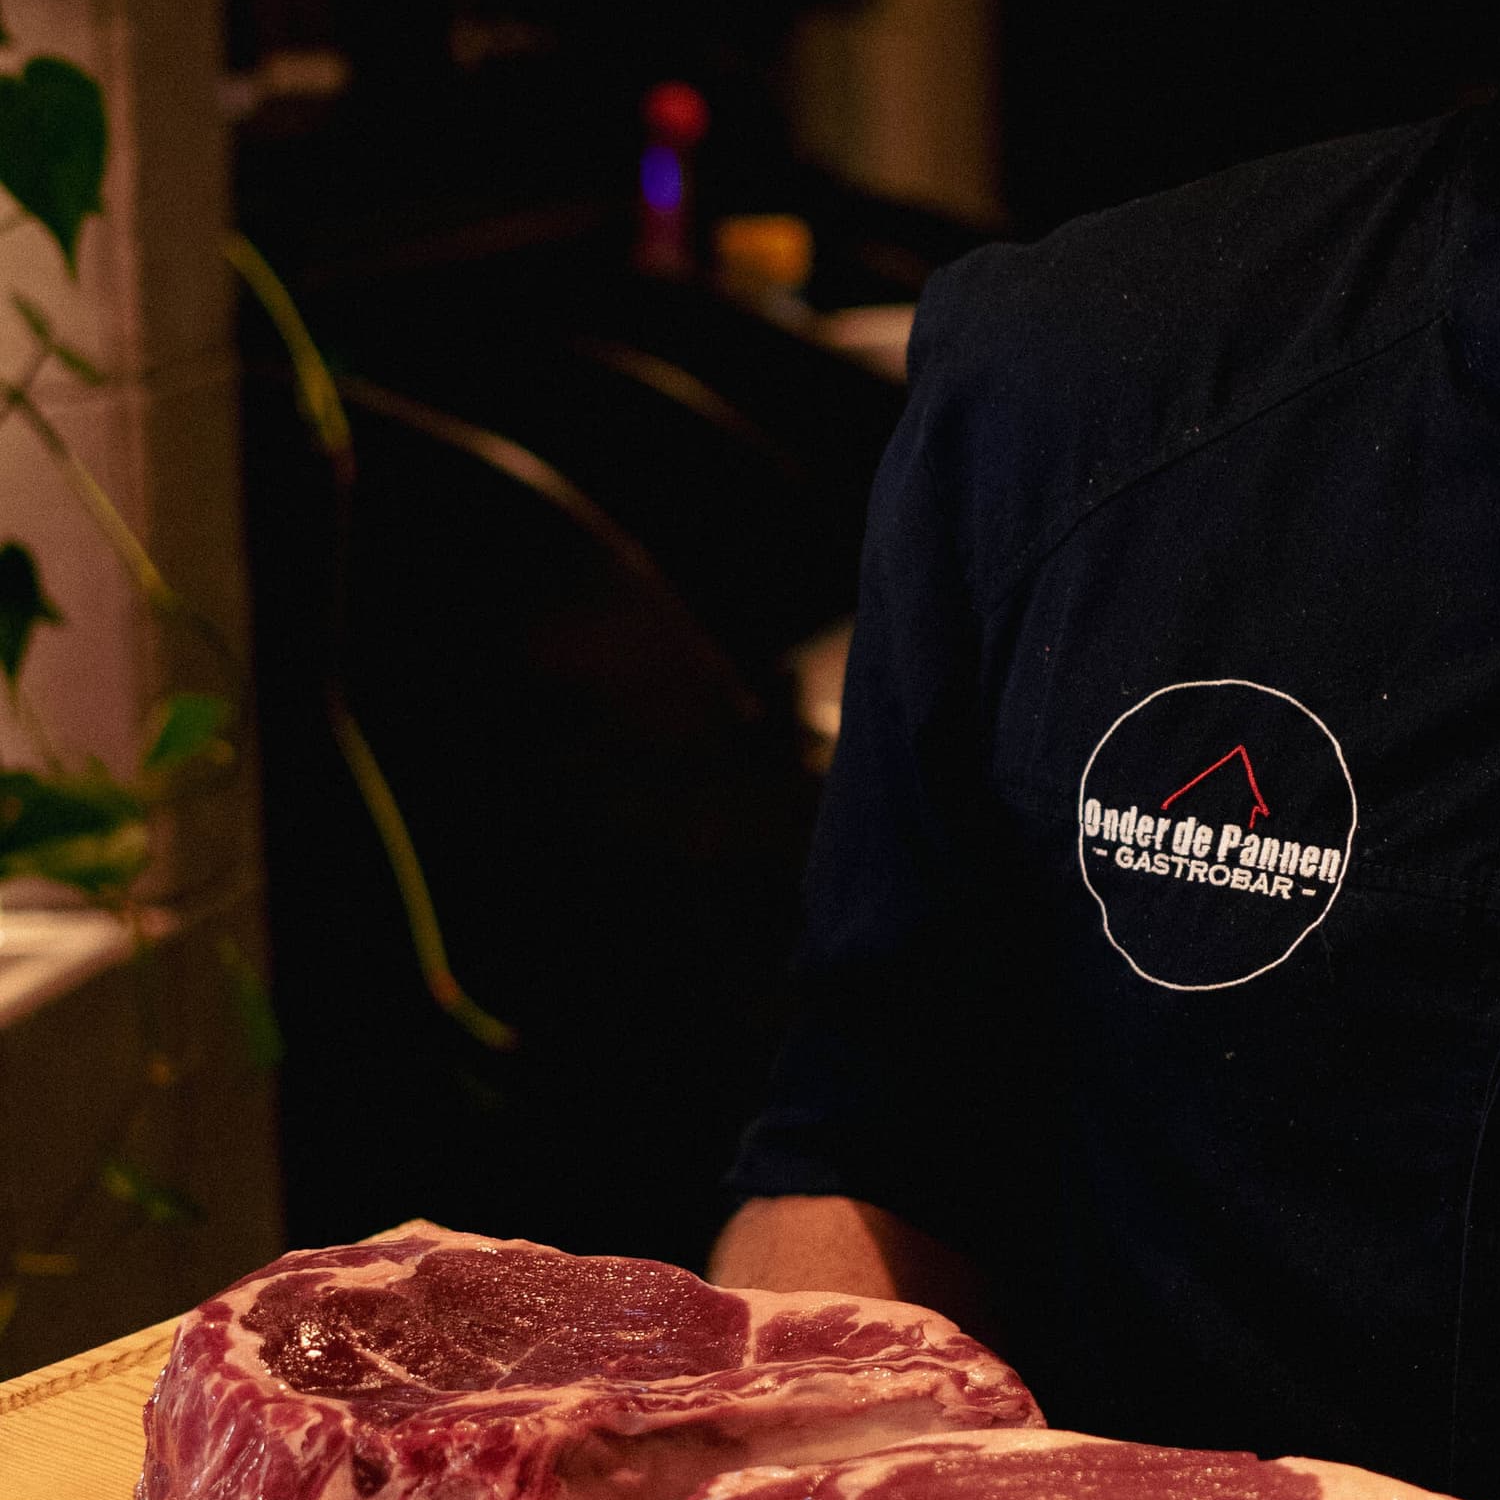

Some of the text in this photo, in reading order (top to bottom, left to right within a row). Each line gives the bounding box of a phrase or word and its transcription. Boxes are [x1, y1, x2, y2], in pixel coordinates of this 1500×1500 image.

[1084, 798, 1342, 884] Onder de Pannen
[1114, 846, 1295, 900] GASTROBAR
